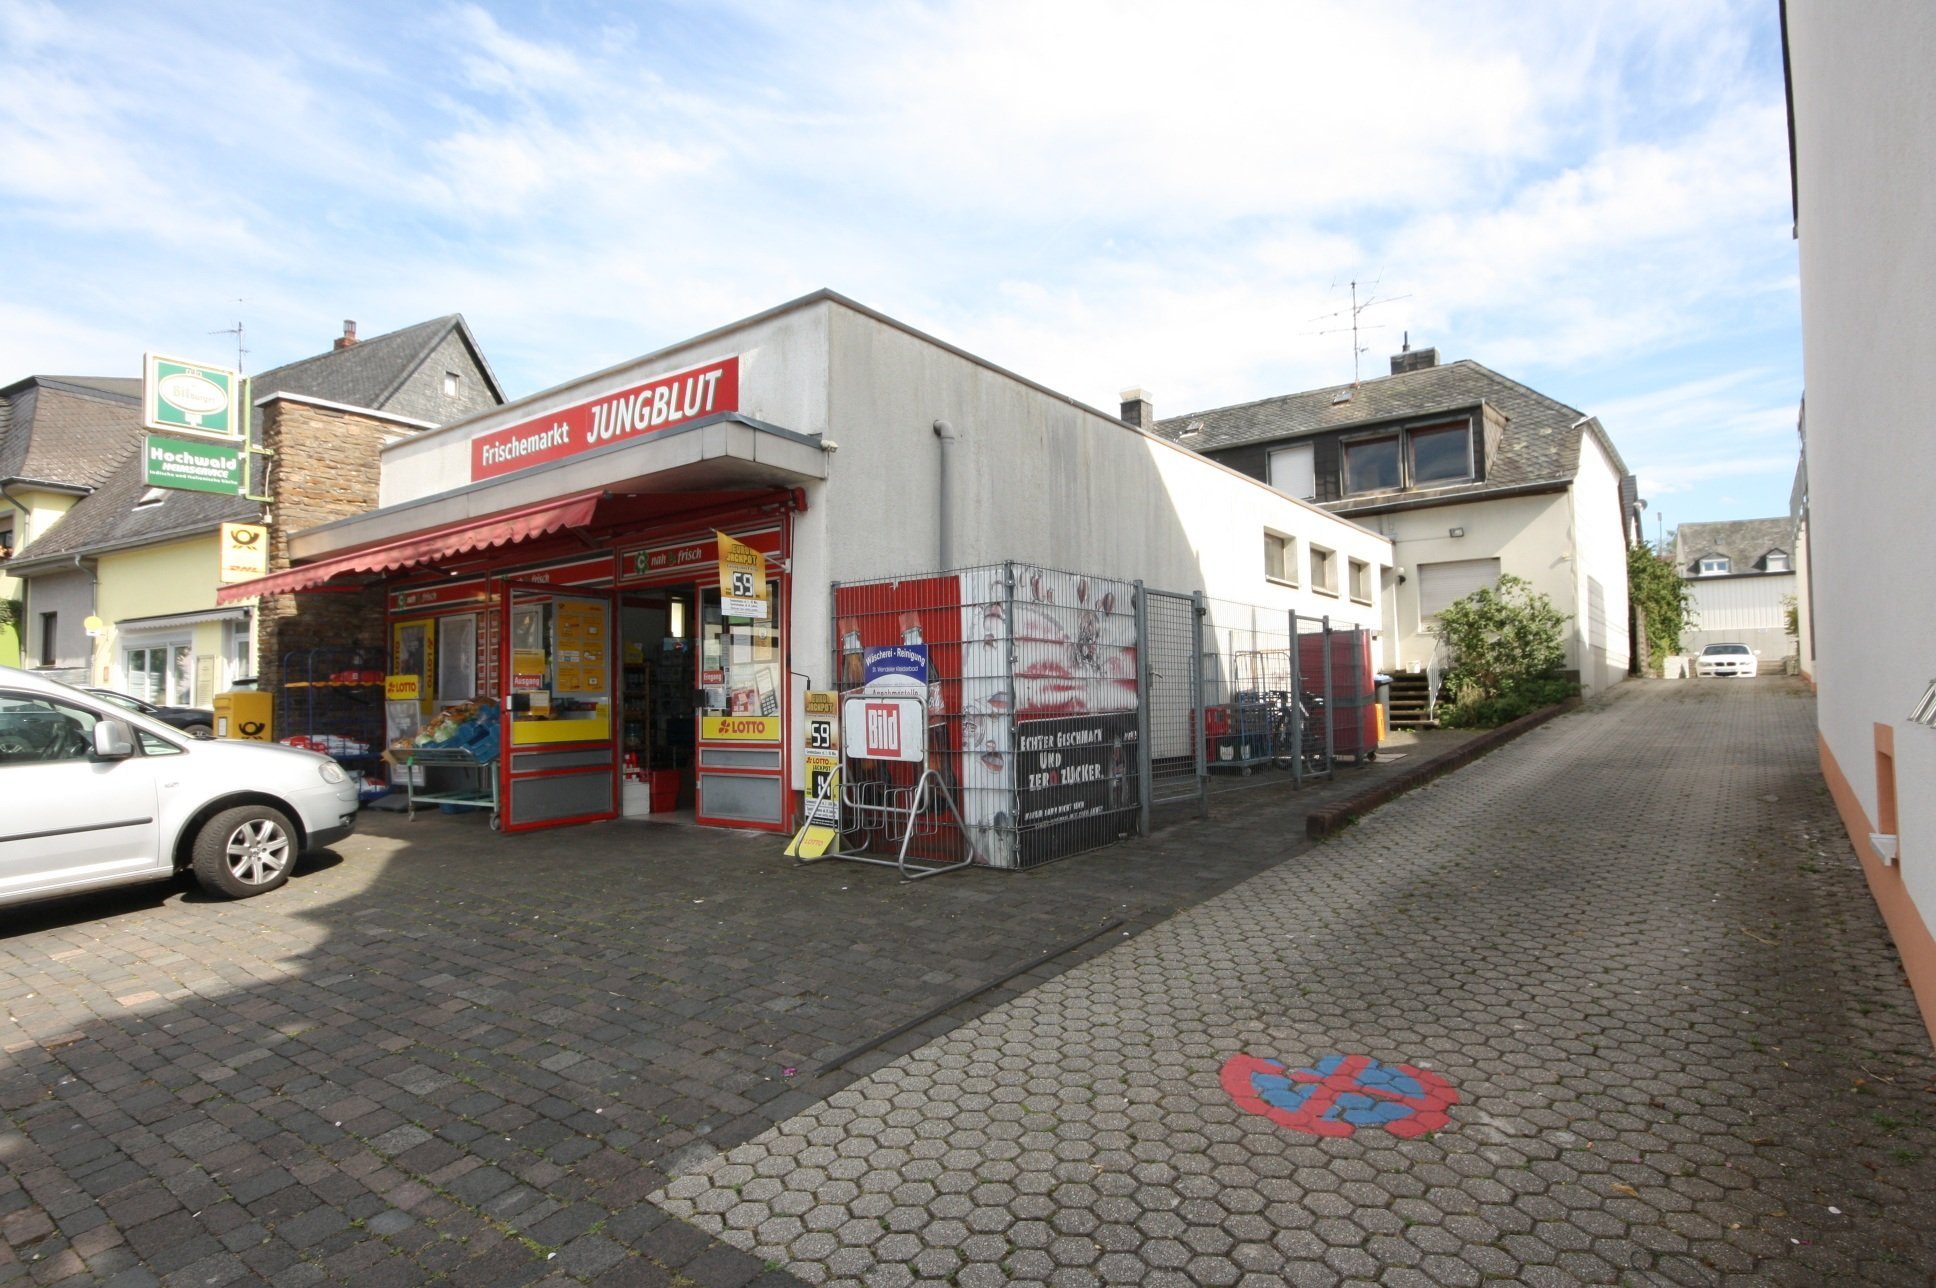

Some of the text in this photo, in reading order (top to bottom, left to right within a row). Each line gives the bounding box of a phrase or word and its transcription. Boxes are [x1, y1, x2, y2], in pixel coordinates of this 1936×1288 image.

[482, 369, 723, 466] Frischemarkt JUNGBLUT
[150, 447, 237, 470] Hochwald
[651, 555, 666, 567] nah
[677, 547, 702, 564] frisch
[727, 552, 757, 565] JACKPOT
[733, 572, 752, 596] 59
[896, 647, 926, 667] Reinigung
[514, 677, 540, 686] Ausgang
[703, 672, 721, 681] Eingang
[396, 682, 416, 693] LOTTO
[806, 702, 834, 713] JACKPOT
[812, 694, 828, 702] EURO
[732, 720, 766, 734] LOTTO
[812, 723, 829, 747] 59
[868, 709, 897, 749] Bild
[1020, 728, 1103, 751] ECHTER GESCHMACK
[1040, 751, 1062, 769] UND
[1060, 764, 1105, 785] ZUCKER.
[804, 838, 824, 847] LOTTO
